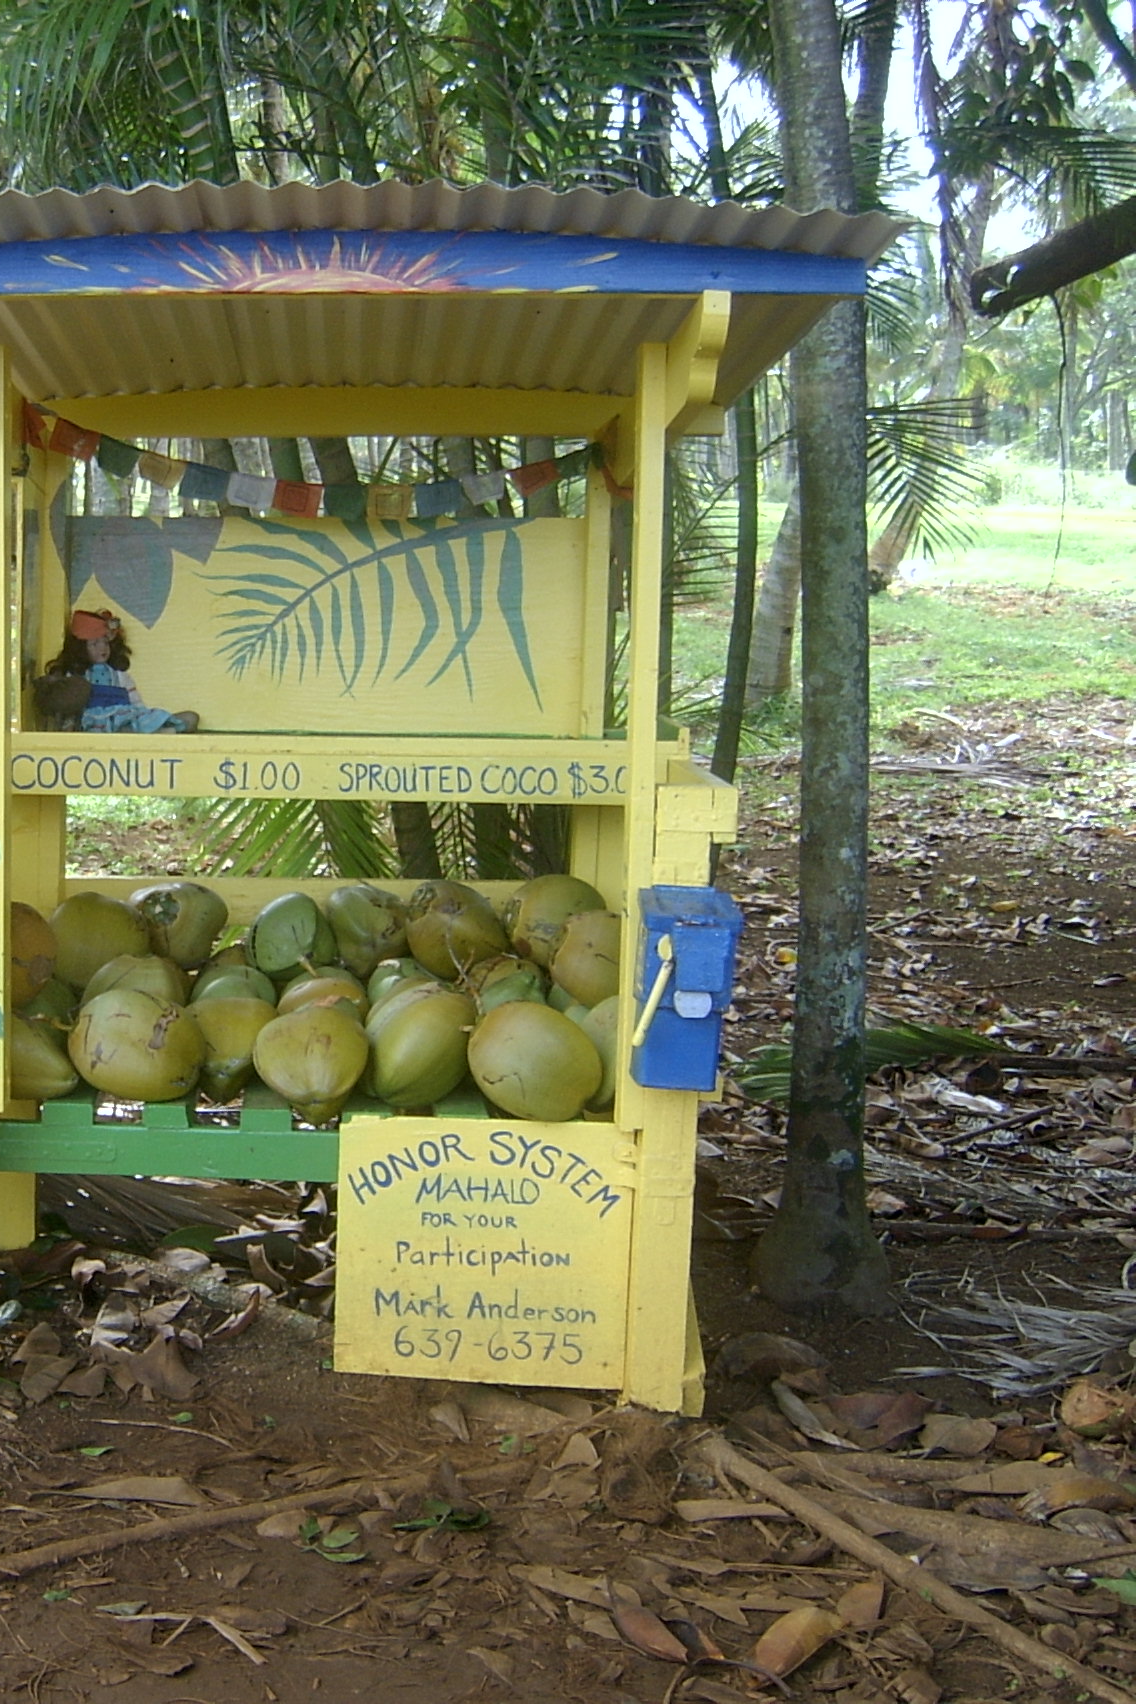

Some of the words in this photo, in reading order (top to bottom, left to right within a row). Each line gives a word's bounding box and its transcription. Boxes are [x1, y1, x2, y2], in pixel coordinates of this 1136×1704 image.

[10, 753, 183, 791] COCONUT
[213, 756, 301, 794] $1.00
[338, 762, 473, 793] SPROUTED
[480, 764, 559, 796] COCO
[347, 1133, 475, 1205] HONOR
[489, 1131, 621, 1219] SYSTEM
[415, 1172, 541, 1205] MAHALO
[420, 1211, 457, 1228] FOR
[463, 1214, 518, 1229] YOUR
[374, 1284, 455, 1319] Mark
[466, 1288, 597, 1325] Anderson
[393, 1324, 584, 1366] 639-6375
